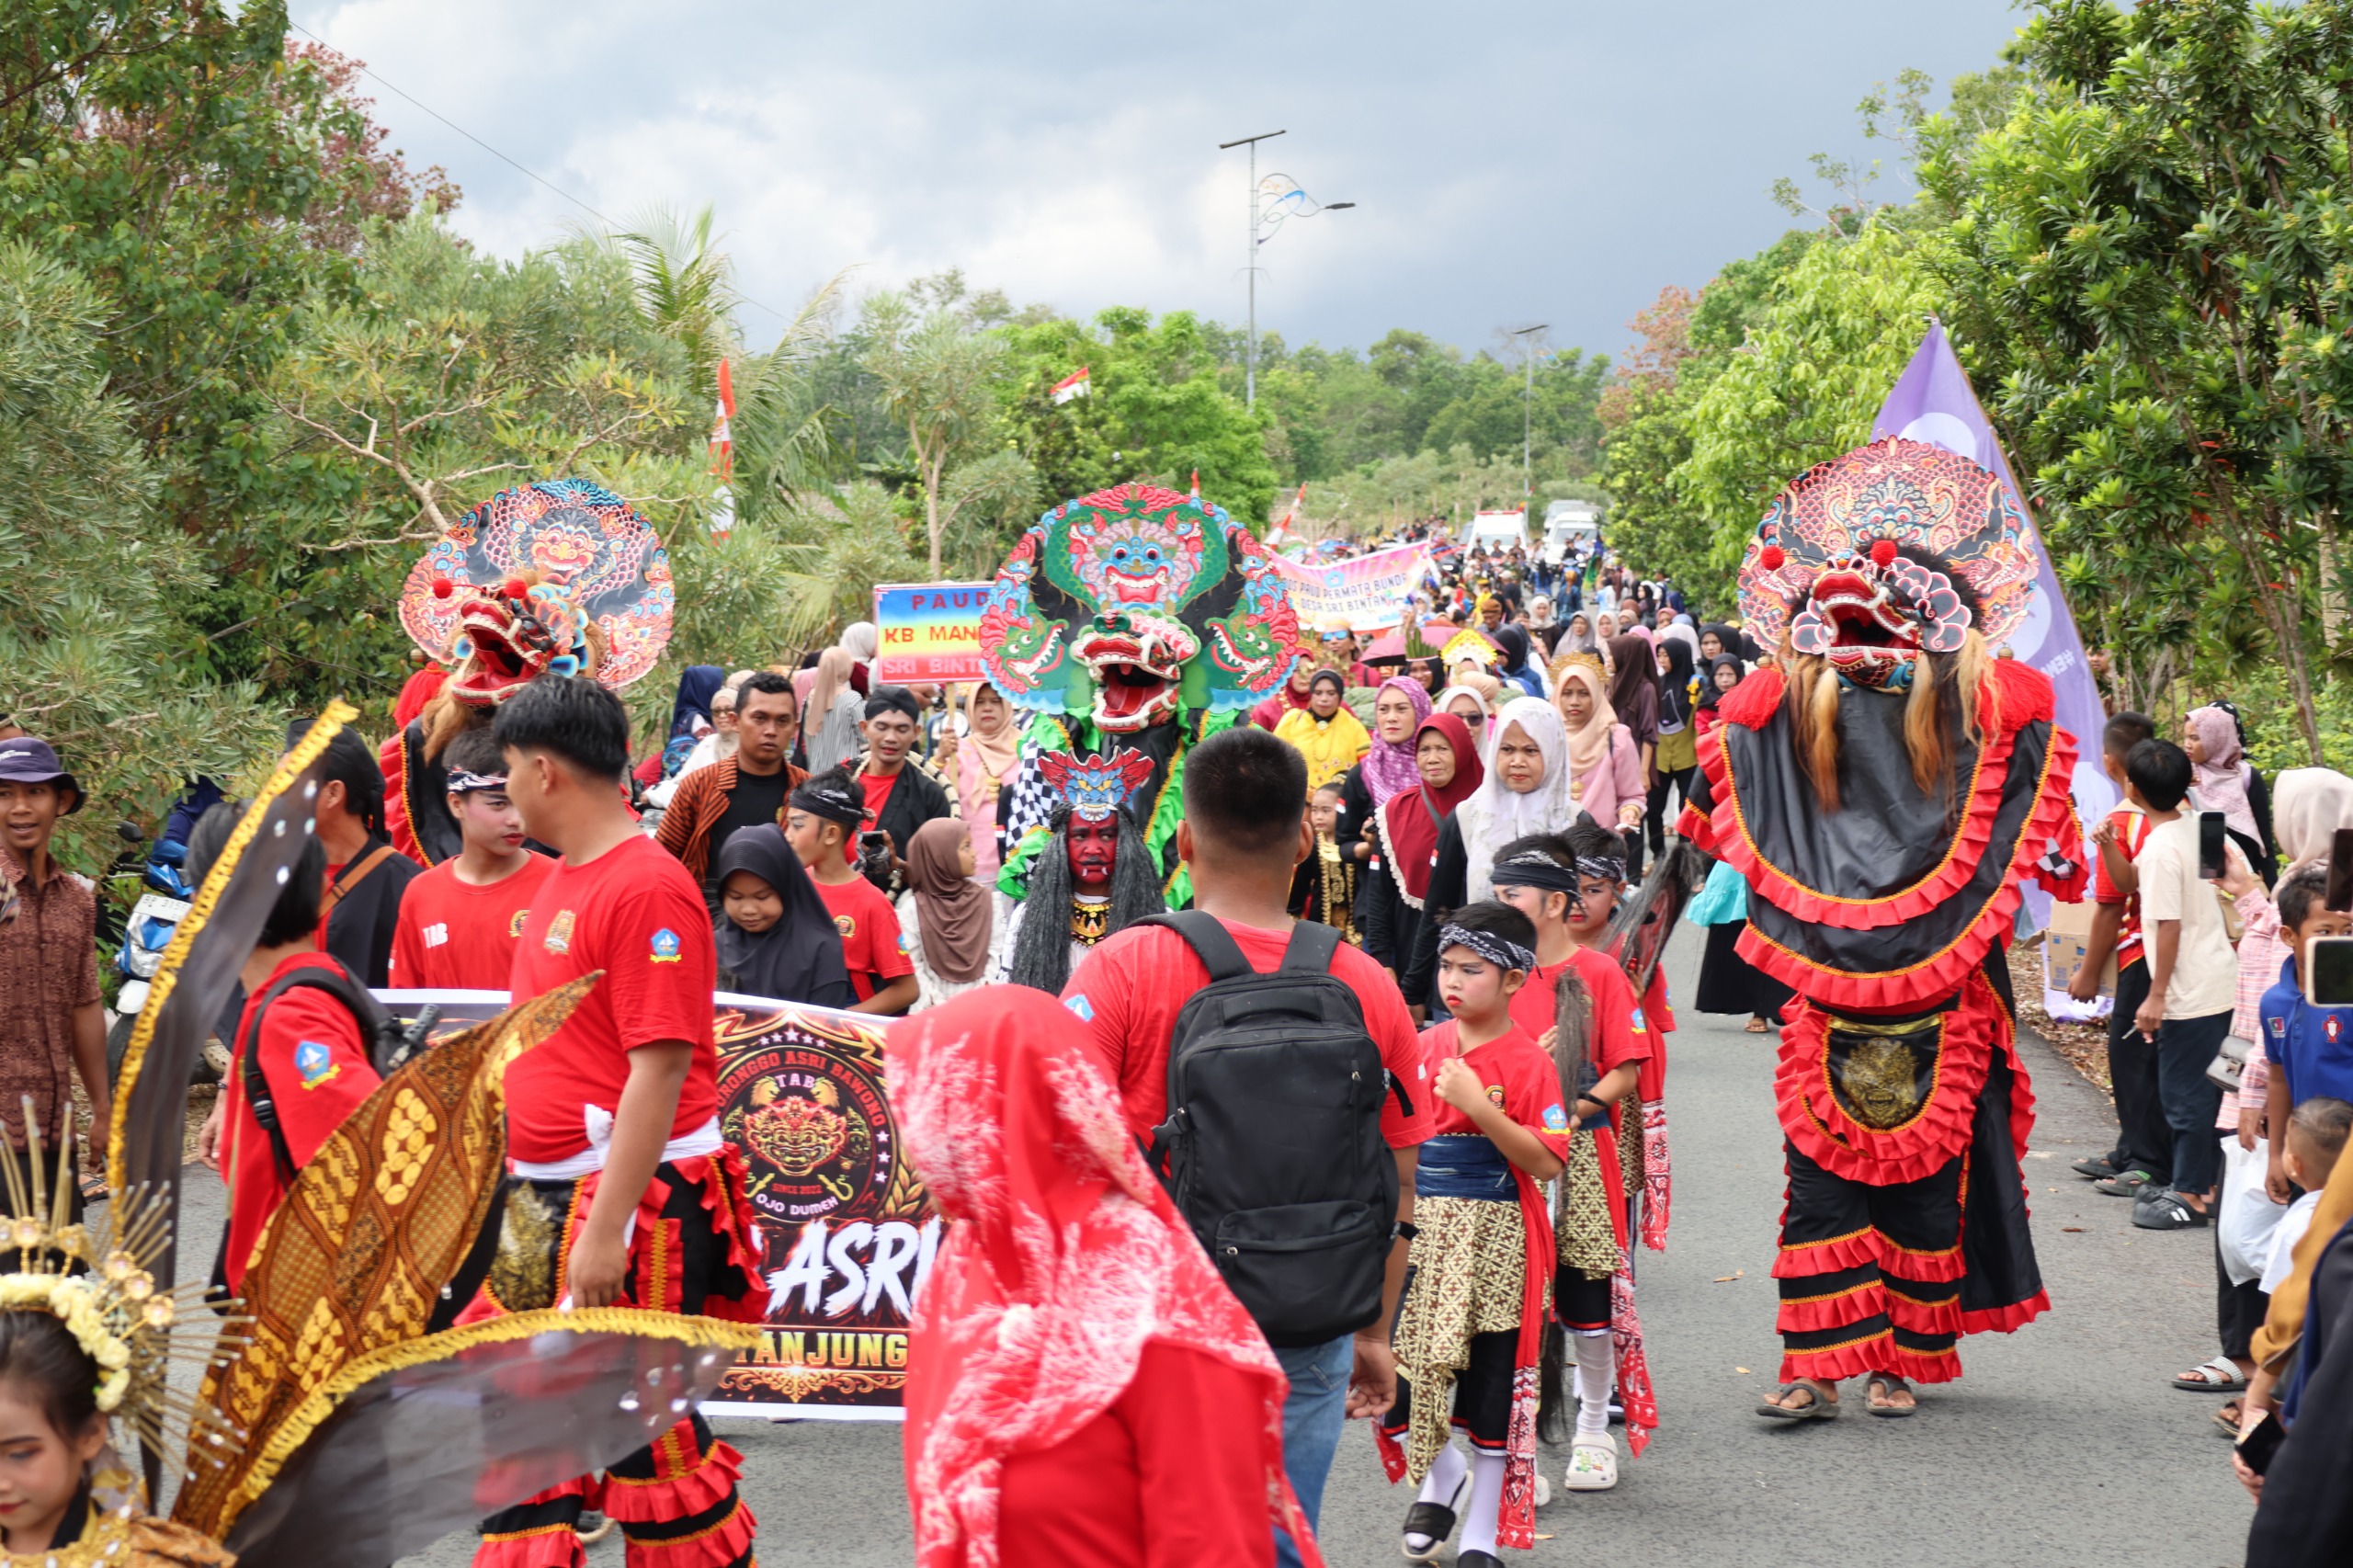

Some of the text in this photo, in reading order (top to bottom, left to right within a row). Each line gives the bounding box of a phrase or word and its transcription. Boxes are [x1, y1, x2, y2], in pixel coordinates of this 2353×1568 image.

[1300, 581, 1321, 598] PAUD
[1324, 583, 1371, 600] PERMATA
[1374, 573, 1407, 590] BUNDA
[911, 591, 989, 611] PAUD
[1301, 597, 1323, 612] DESA
[1326, 601, 1343, 613] SRI
[884, 626, 980, 643] KB MAN
[882, 657, 917, 675] SRI
[422, 922, 449, 949] TAB
[717, 1050, 887, 1128] URONGGO ASRI BAWONO
[775, 1073, 816, 1089] TAB
[771, 1183, 799, 1195] SINCE
[755, 1192, 786, 1213] OJO
[765, 1213, 941, 1322] ASRI
